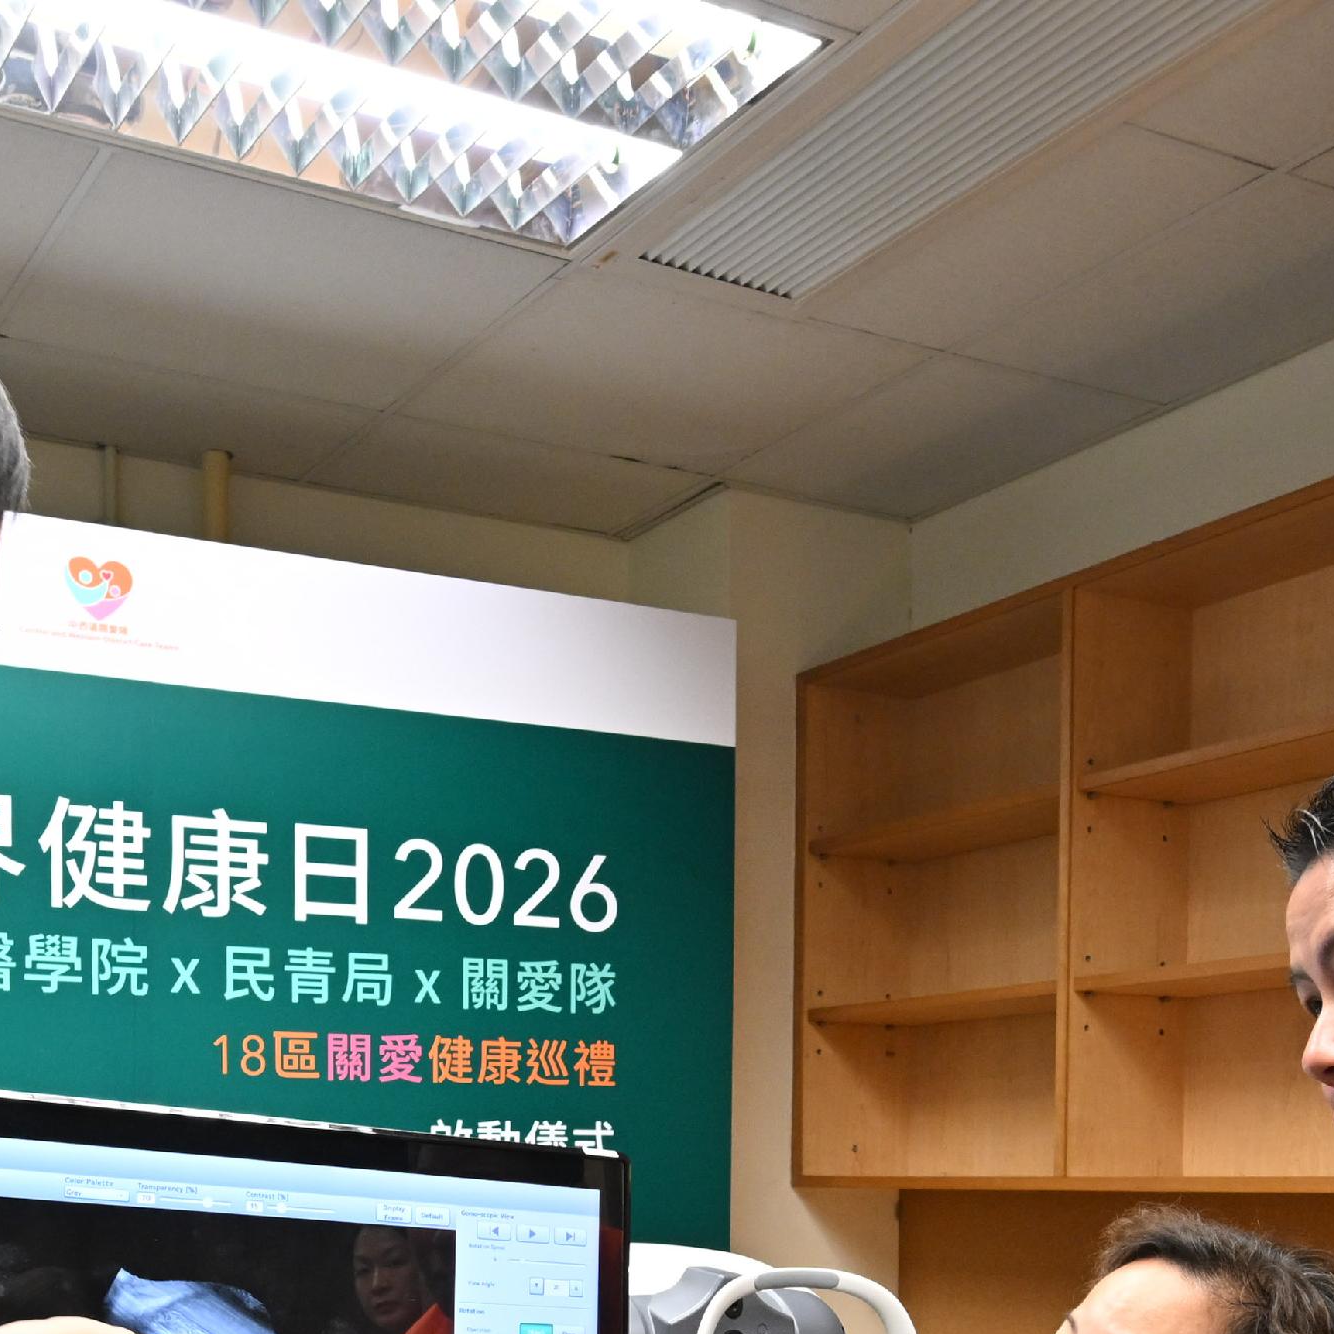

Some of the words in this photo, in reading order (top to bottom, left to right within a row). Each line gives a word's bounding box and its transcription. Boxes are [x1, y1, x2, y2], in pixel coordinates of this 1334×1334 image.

[171, 957, 202, 995] x
[222, 945, 394, 1009] 民青局
[414, 967, 442, 1005] x
[461, 956, 618, 1015] 關愛隊
[212, 1030, 617, 1088] 18區關愛健康巡禮
